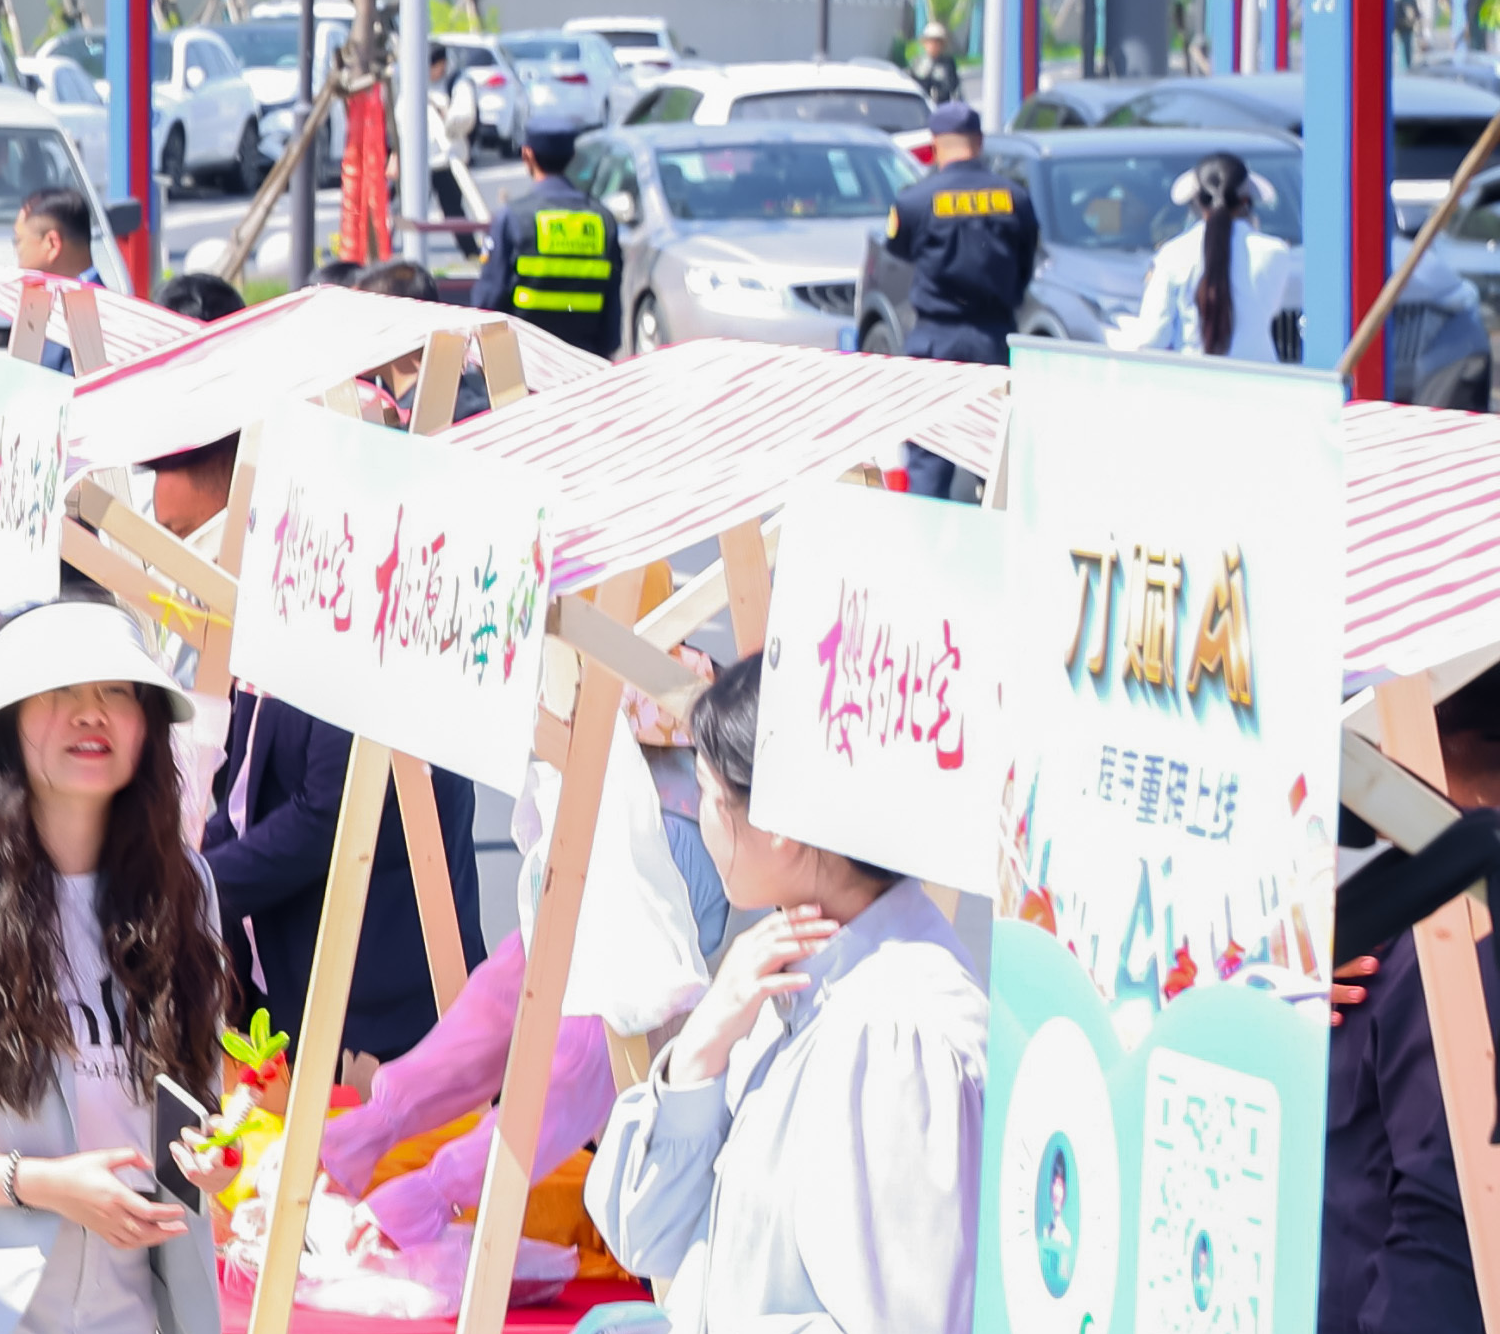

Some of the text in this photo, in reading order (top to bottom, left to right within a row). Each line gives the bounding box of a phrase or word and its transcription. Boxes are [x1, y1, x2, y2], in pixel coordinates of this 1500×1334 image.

[373, 503, 498, 685] 桃源山海
[816, 577, 966, 771] 樱约北宅
